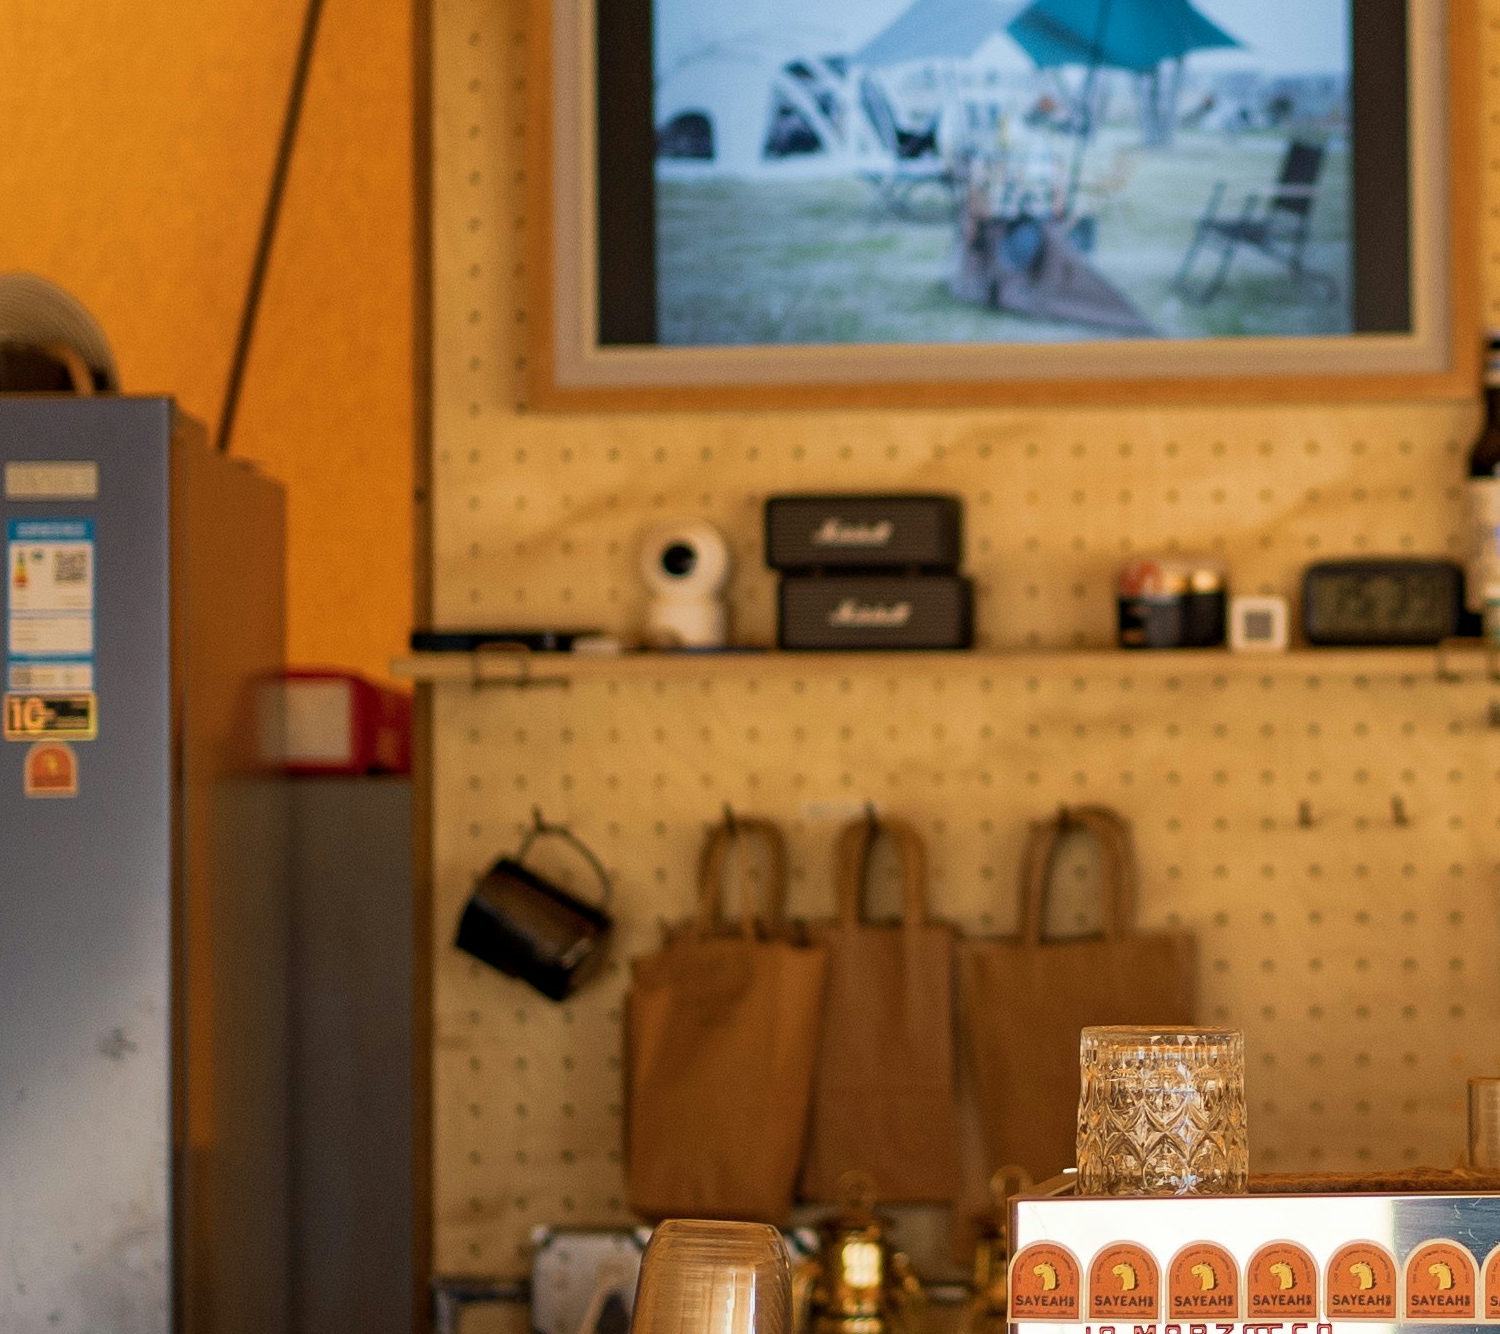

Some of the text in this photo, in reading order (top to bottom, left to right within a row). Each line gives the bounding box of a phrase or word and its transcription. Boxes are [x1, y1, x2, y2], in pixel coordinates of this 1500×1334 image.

[1016, 1295, 1068, 1307] SAYEAH
[1095, 1295, 1146, 1307] SAYEAH
[1174, 1295, 1225, 1307] SAYEAH
[1253, 1295, 1305, 1307] SAYEAH
[1332, 1295, 1384, 1307] SAYEAH
[1411, 1295, 1463, 1307] SAYEAH
